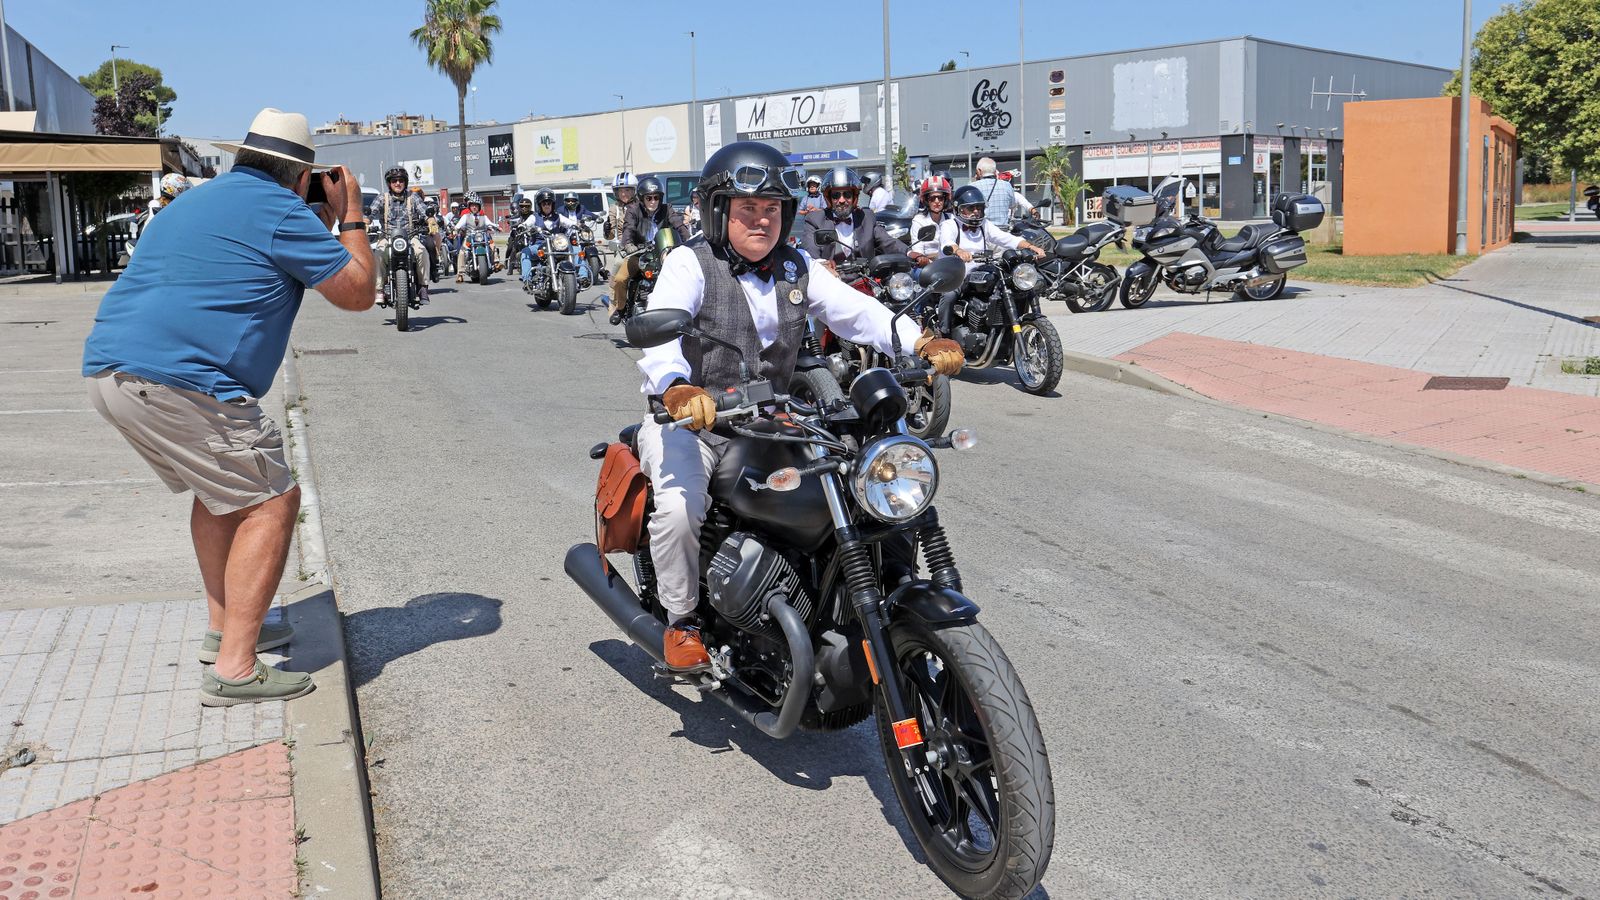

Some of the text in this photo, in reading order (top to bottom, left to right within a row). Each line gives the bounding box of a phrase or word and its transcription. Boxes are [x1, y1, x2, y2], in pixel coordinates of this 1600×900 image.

[972, 79, 1008, 109] Cool
[747, 131, 772, 140] TALLER
[773, 128, 811, 138] MECANICO
[819, 124, 848, 134] VENTAS
[1084, 145, 1113, 156] POTENCIA
[1087, 211, 1104, 219] STO
